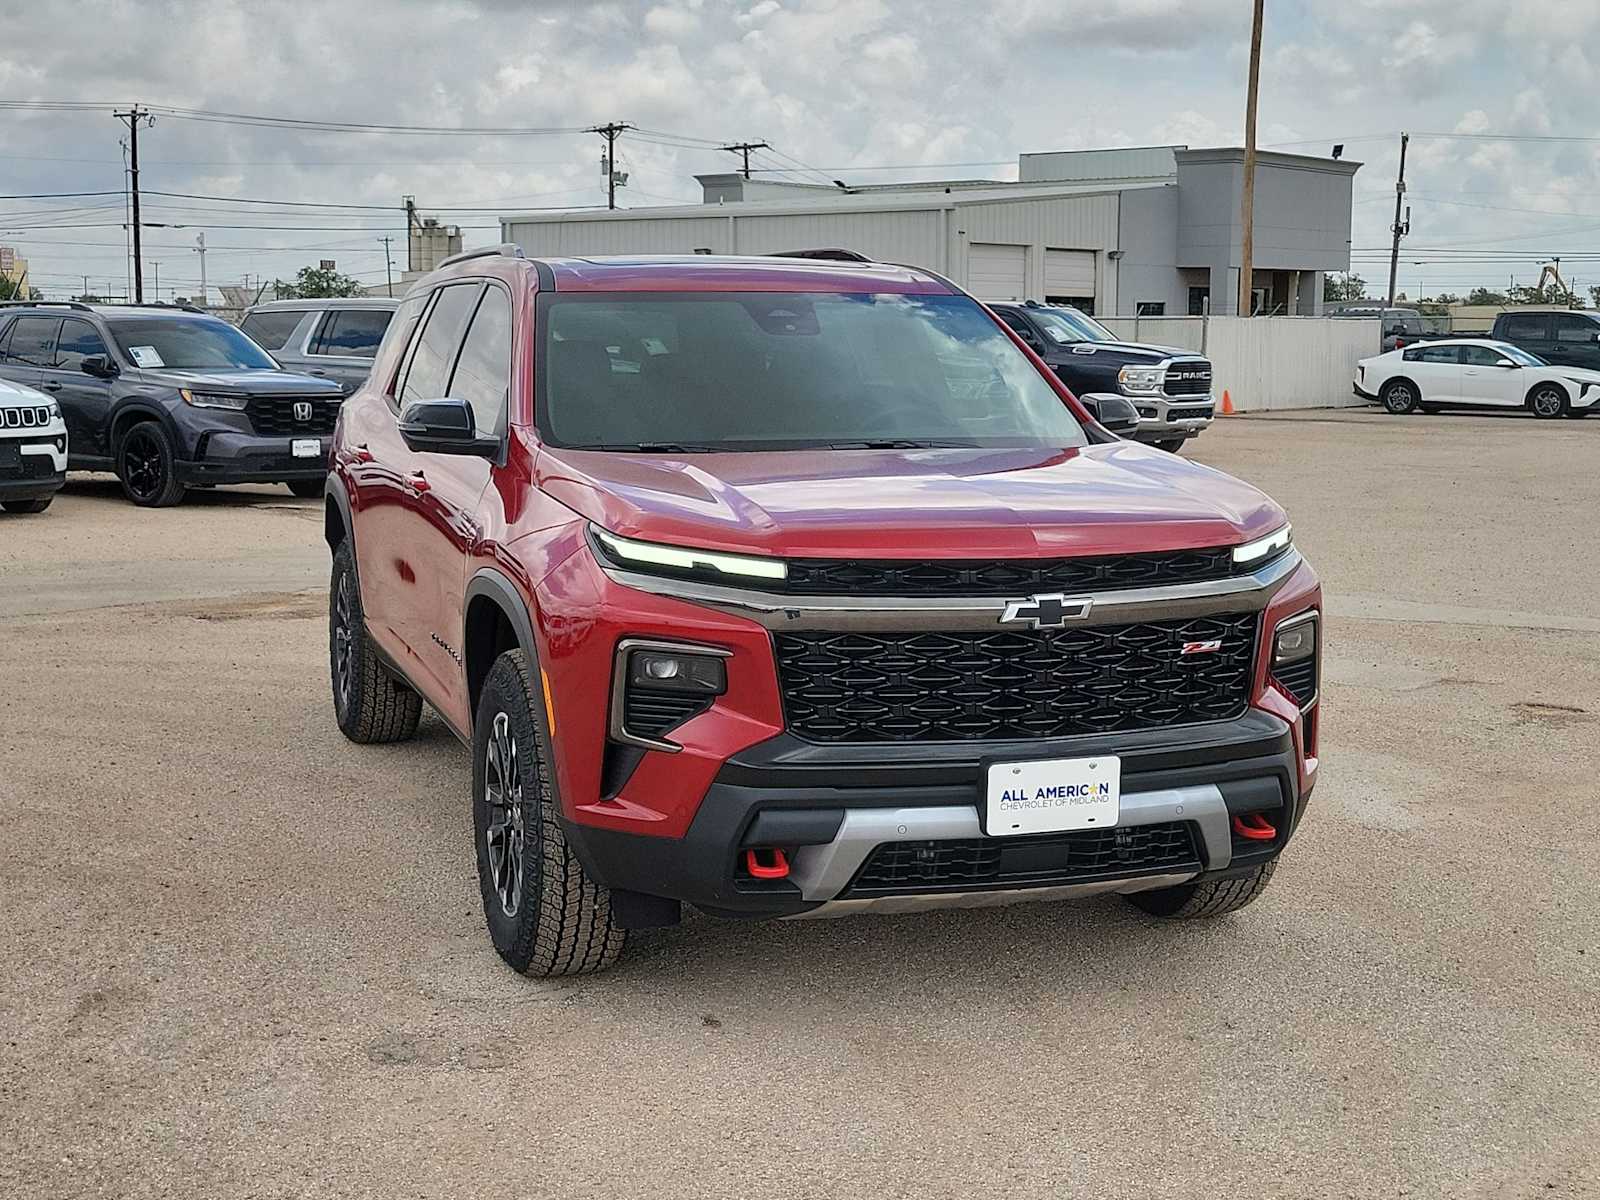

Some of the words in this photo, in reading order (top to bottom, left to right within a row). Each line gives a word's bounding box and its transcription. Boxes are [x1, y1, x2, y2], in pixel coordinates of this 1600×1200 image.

[1001, 789, 1028, 802] ALL
[1000, 800, 1053, 811] CHEVROLET
[1055, 799, 1066, 807] OF
[1069, 795, 1109, 805] MIDLAND
